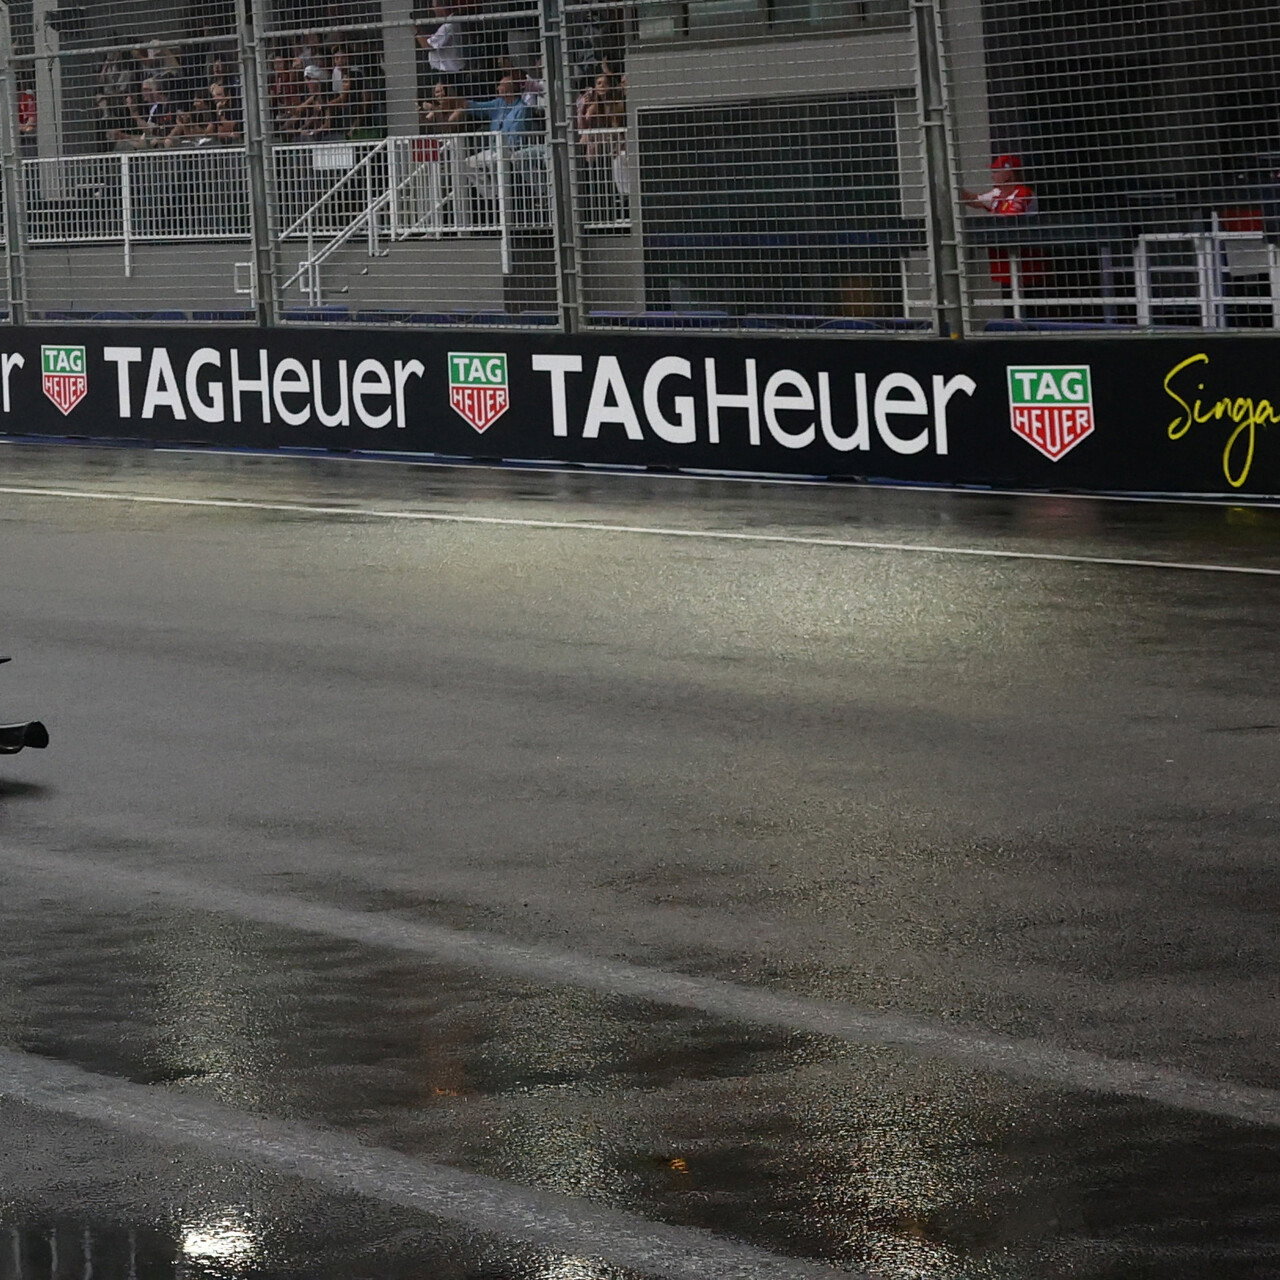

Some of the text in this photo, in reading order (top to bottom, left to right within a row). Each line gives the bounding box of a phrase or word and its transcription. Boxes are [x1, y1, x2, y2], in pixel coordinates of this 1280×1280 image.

[43, 348, 85, 372] TAG
[453, 357, 504, 383] TAG
[43, 375, 87, 413] HEUER
[1014, 370, 1085, 401] TAG
[451, 387, 508, 432] HEUER
[1012, 406, 1094, 459] HEUER
